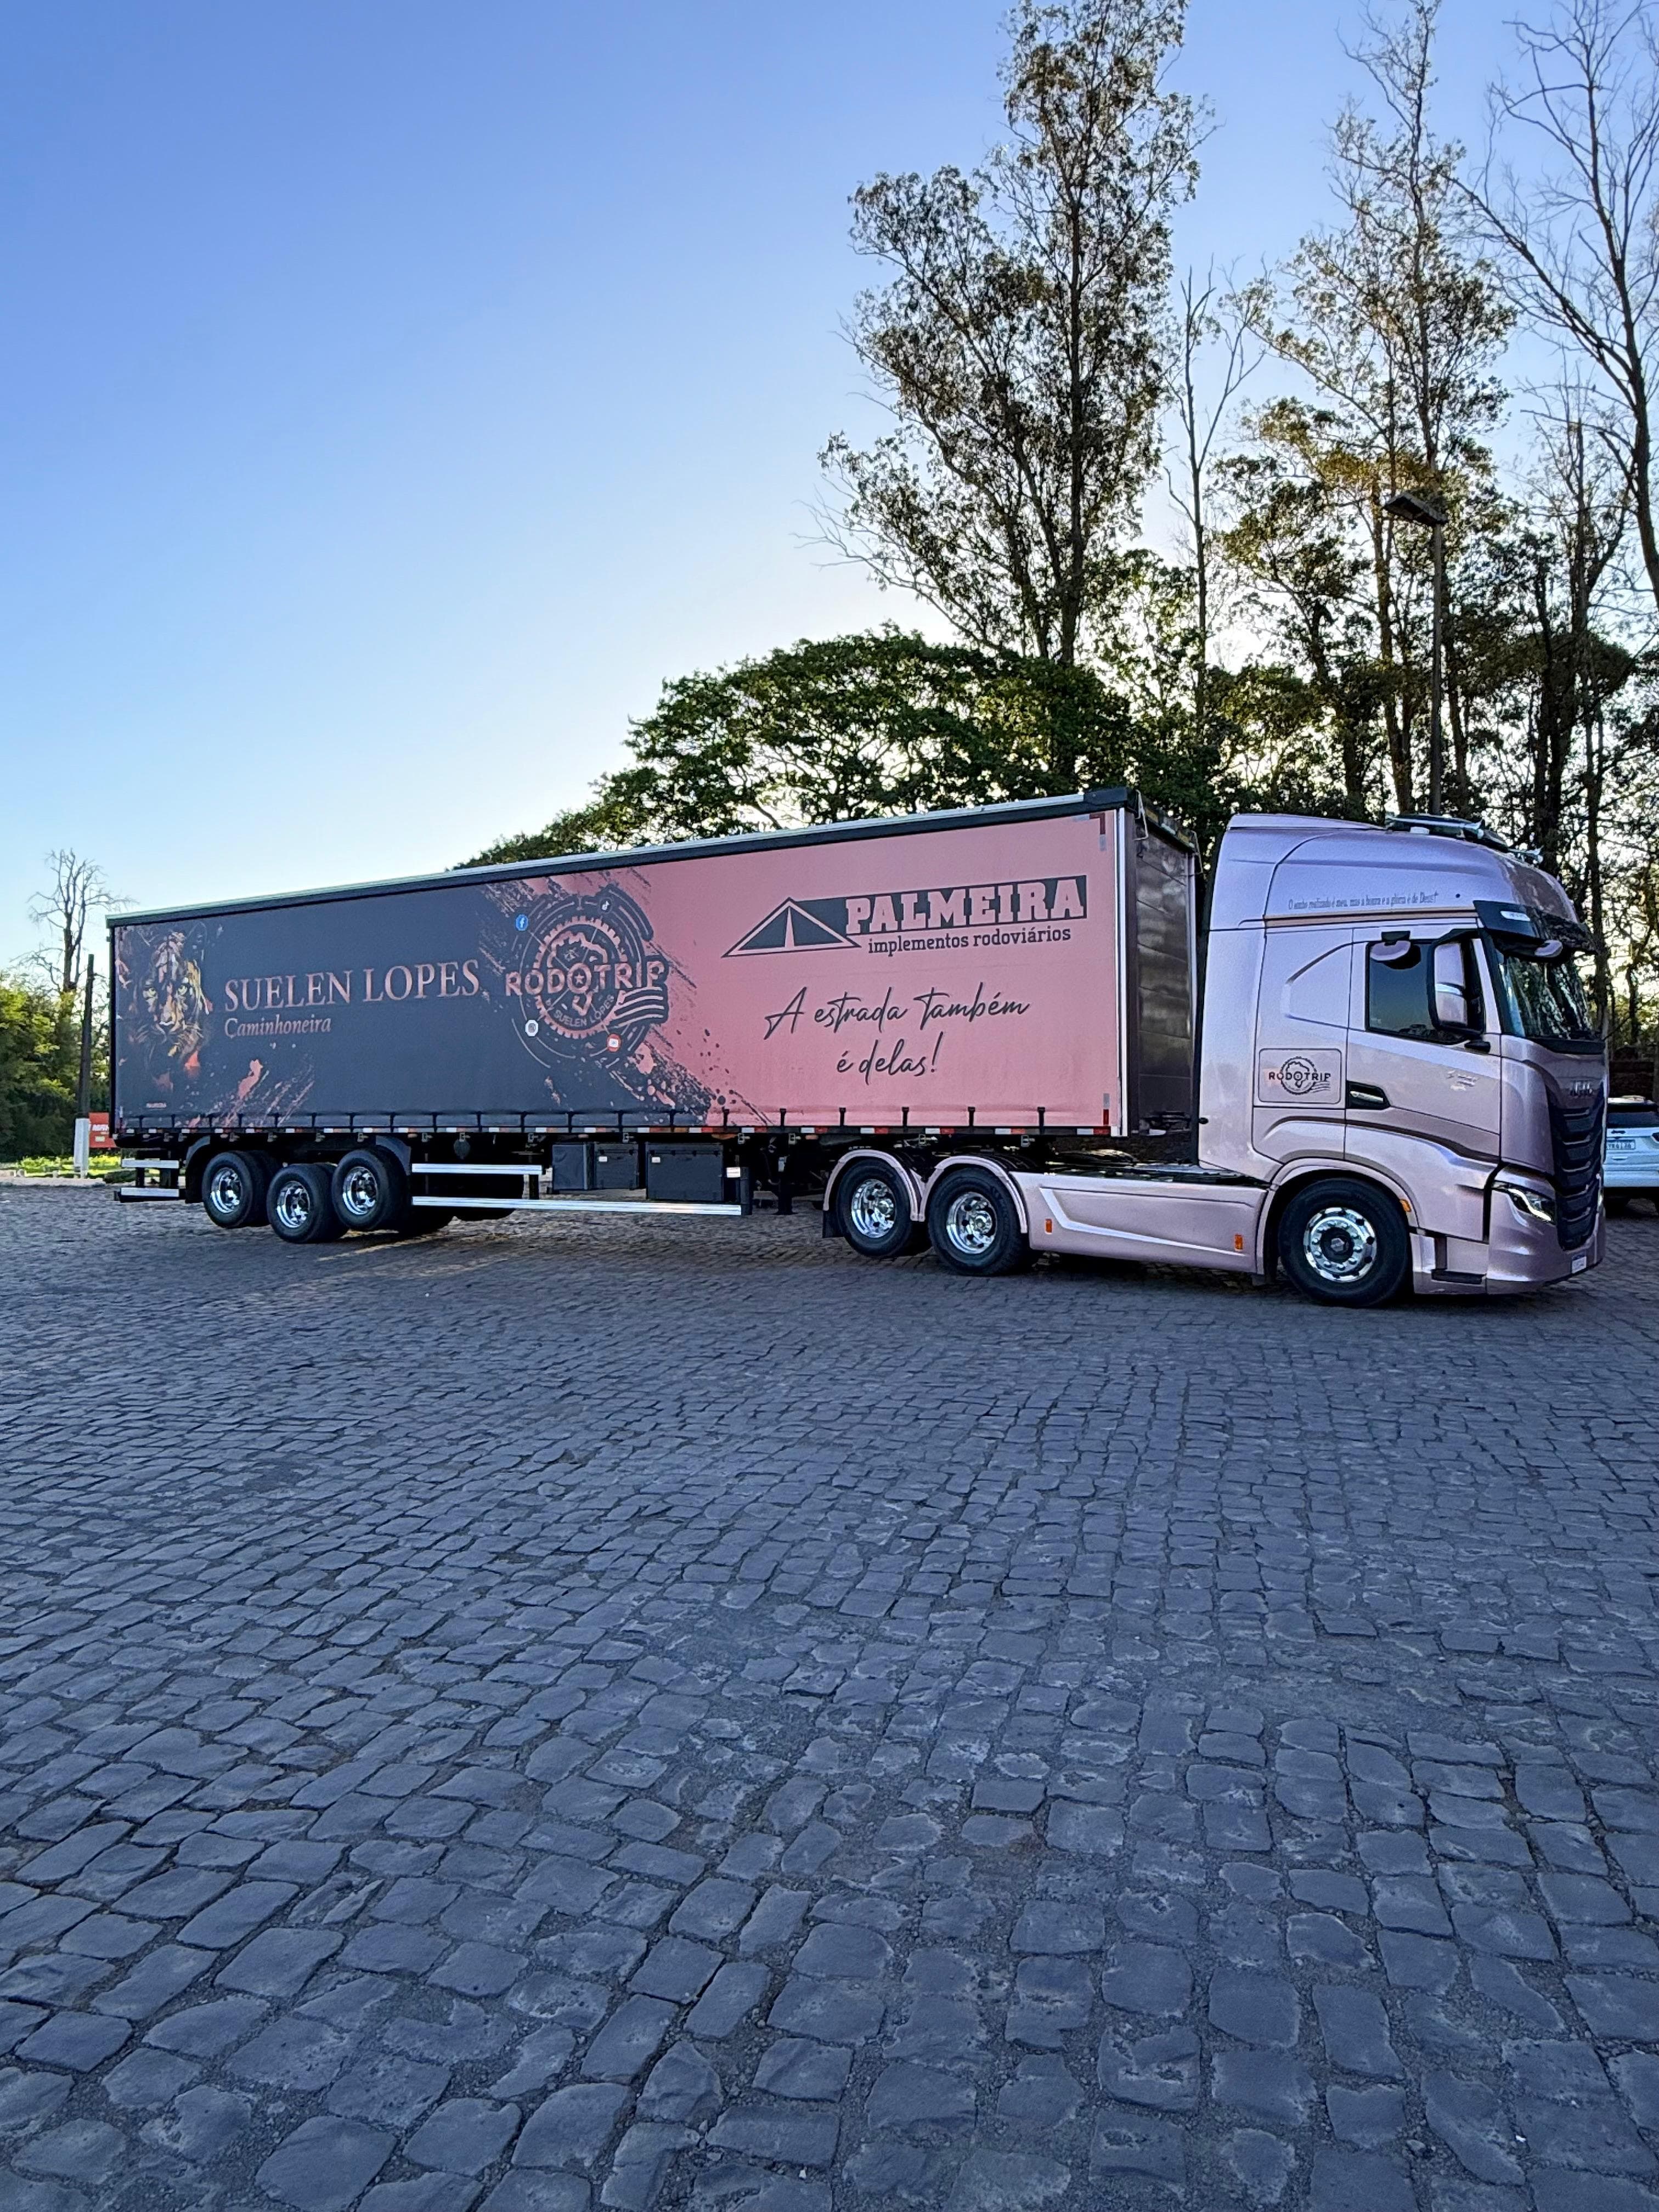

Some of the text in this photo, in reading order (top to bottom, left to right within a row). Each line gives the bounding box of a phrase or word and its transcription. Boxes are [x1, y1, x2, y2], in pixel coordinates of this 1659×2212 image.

[846, 879, 1084, 933] PALMEIRA
[868, 927, 1071, 957] implementos rodoviários
[225, 959, 480, 1012] SUELEN LOPES
[506, 960, 665, 996] RODOTRIP
[225, 1014, 332, 1038] Caminhoneira
[554, 994, 614, 1027] SUELEN LOPES
[764, 982, 1031, 1040] A estrada também
[836, 1031, 944, 1085] é delas!
[1268, 1071, 1331, 1082] RODOTRIP
